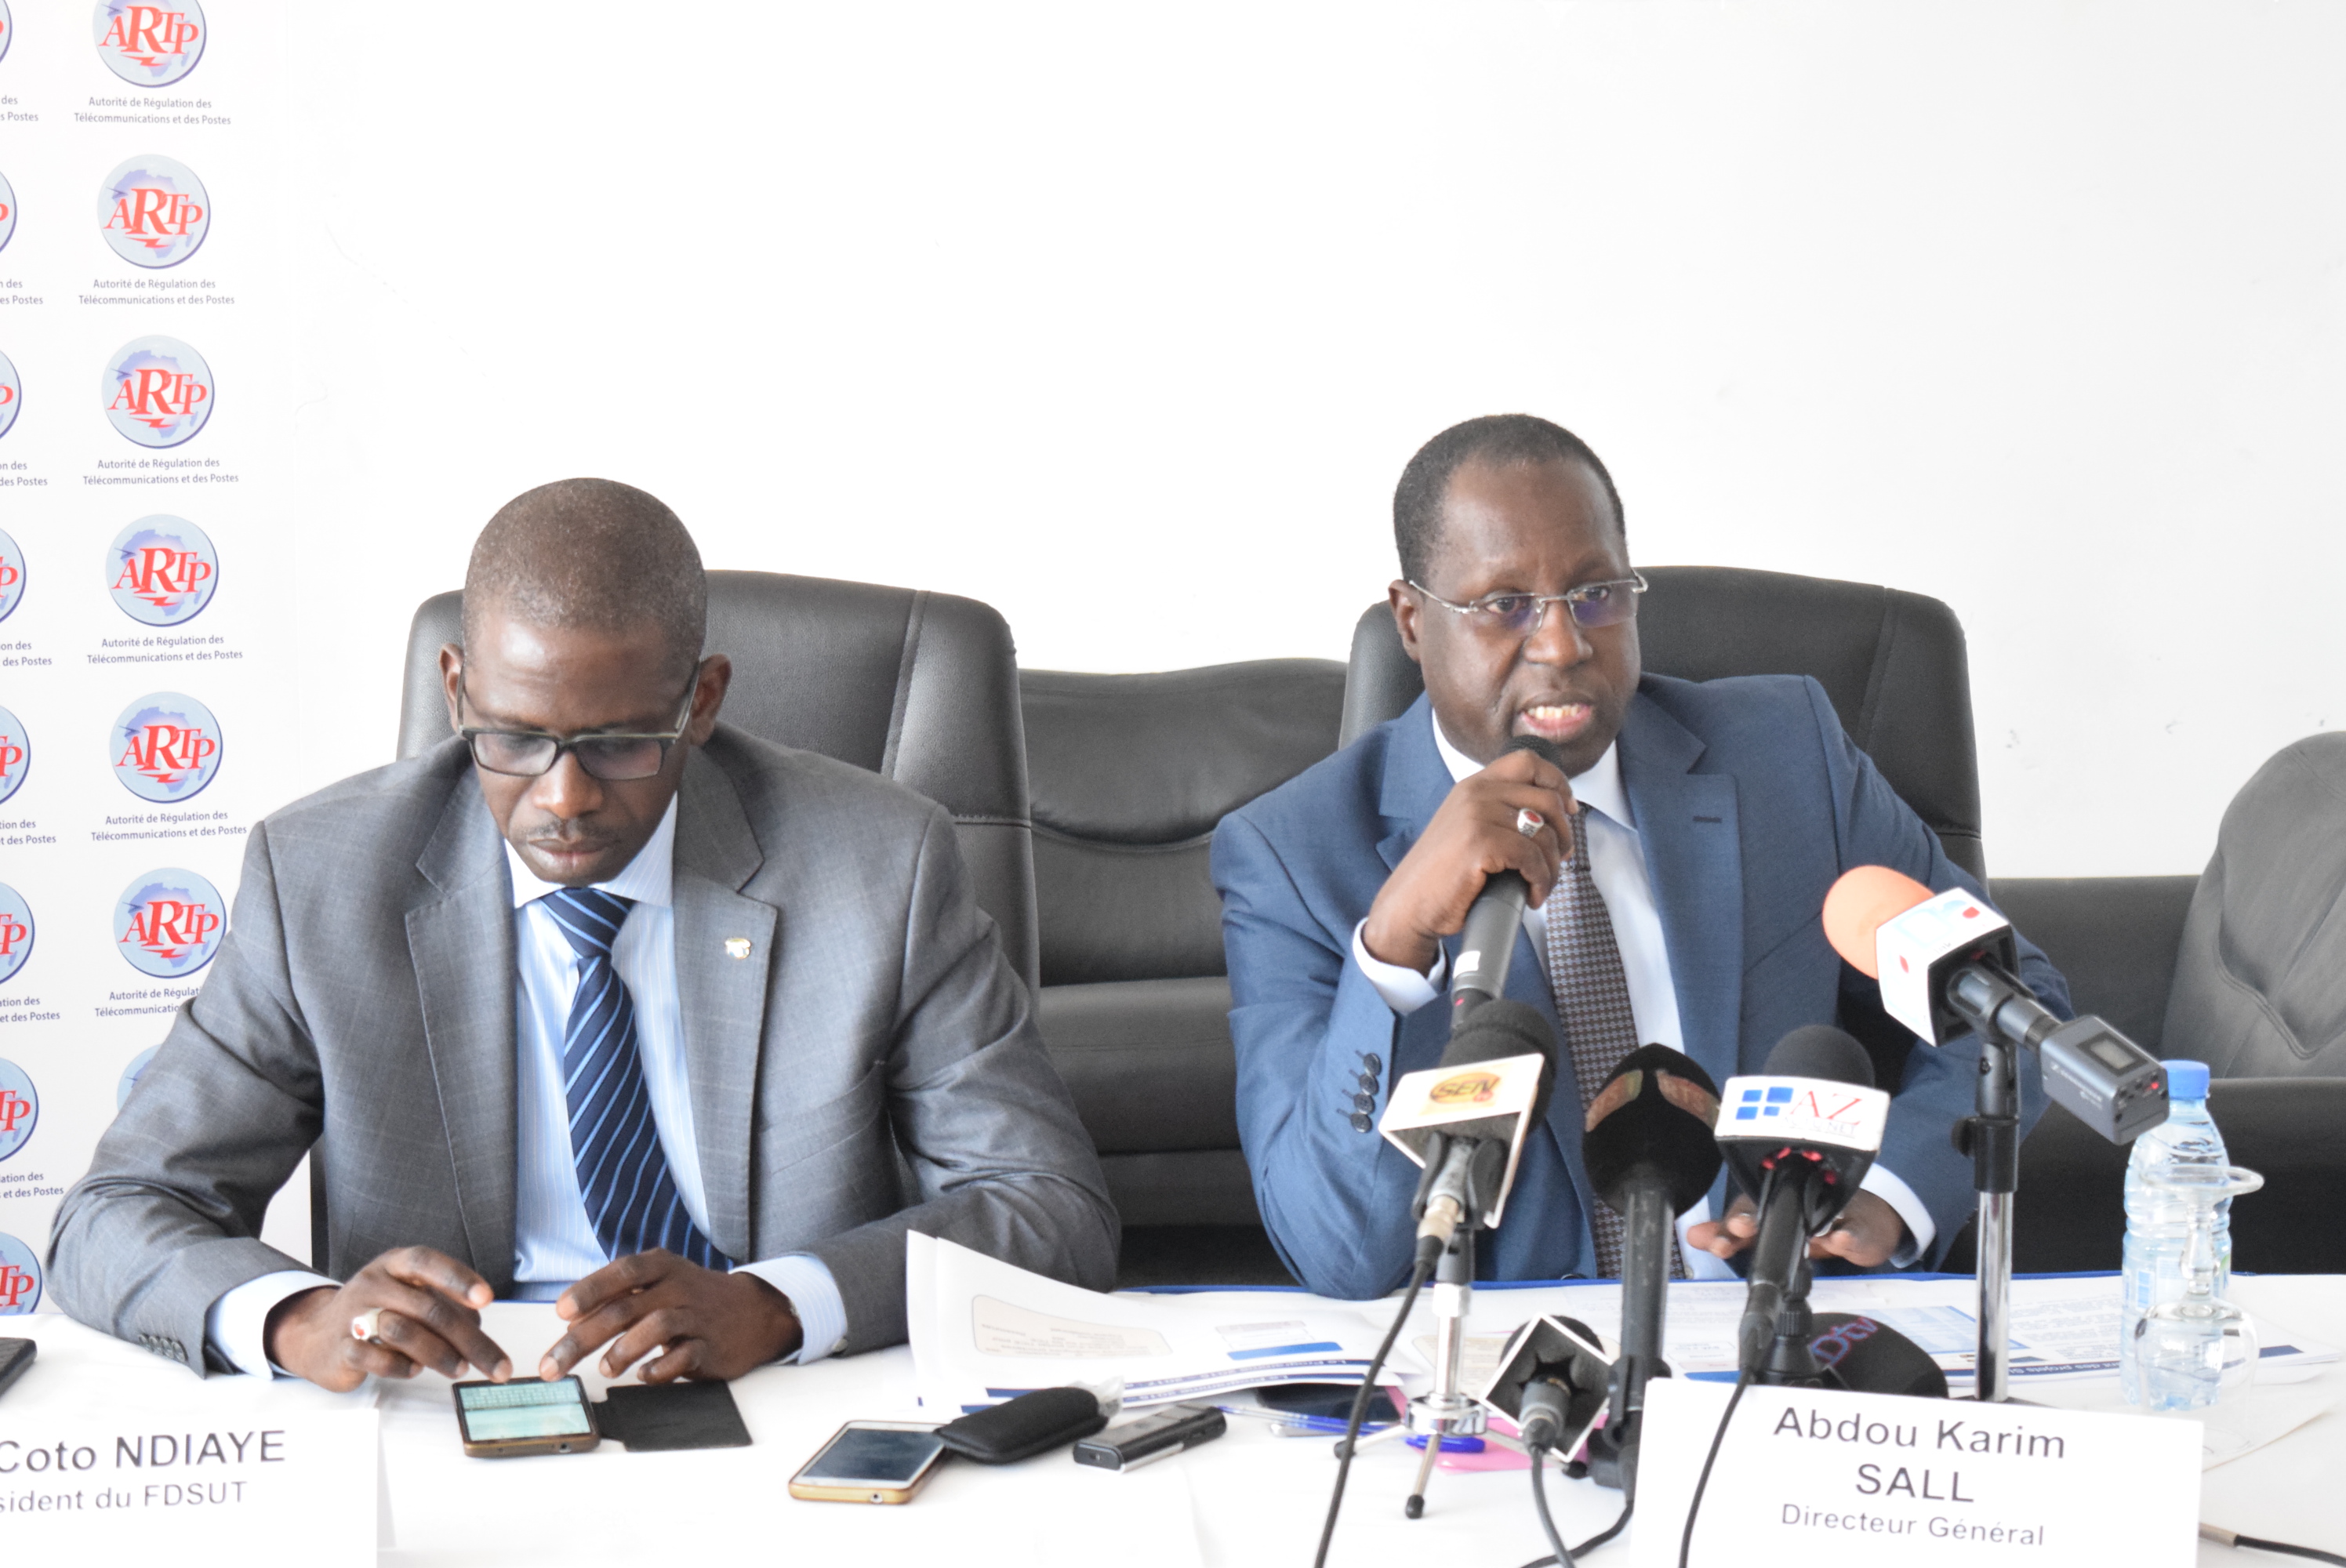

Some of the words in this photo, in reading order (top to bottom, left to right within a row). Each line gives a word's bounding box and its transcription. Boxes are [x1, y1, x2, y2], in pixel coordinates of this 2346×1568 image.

[99, 5, 198, 54] ARTP
[2, 95, 17, 105] des
[89, 97, 127, 107] Autorité
[130, 97, 141, 107] de
[144, 98, 193, 109] Régulation
[196, 99, 212, 108] des
[8, 112, 38, 122] Postes
[74, 113, 170, 124] Télécommunications
[172, 115, 181, 124] et
[184, 115, 199, 125] des
[202, 115, 231, 125] Postes
[103, 188, 202, 235] ARTP
[6, 279, 22, 289] des
[93, 279, 132, 289] Autorité
[135, 279, 145, 289] de
[148, 279, 198, 290] Régulation
[201, 279, 216, 289] des
[13, 296, 43, 305] Postes
[79, 295, 174, 304] Télécommunications
[177, 296, 185, 304] et
[188, 295, 203, 304] des
[206, 296, 234, 304] Postes
[107, 368, 207, 415] ARTP
[11, 461, 27, 470] des
[98, 459, 136, 469] Autorité
[139, 459, 150, 469] de
[153, 459, 202, 470] Régulation
[205, 458, 220, 467] des
[17, 477, 47, 486] Postes
[83, 475, 179, 485] Télécommunications
[181, 475, 190, 484] et
[193, 474, 208, 484] des
[211, 474, 239, 483] Postes
[111, 547, 211, 593] ARTP
[16, 641, 31, 651] des
[102, 637, 140, 648] Autorité
[143, 637, 154, 647] de
[157, 636, 206, 648] Régulation
[209, 635, 223, 644] des
[2, 657, 19, 666] des
[22, 657, 52, 666] Postes
[87, 652, 183, 663] Télécommunications
[186, 652, 194, 661] et
[197, 651, 212, 660] des
[215, 651, 243, 659] Postes
[116, 724, 216, 771] ARTP
[20, 819, 36, 829] des
[106, 815, 143, 825] Autorité
[147, 814, 158, 823] de
[161, 812, 210, 824] Régulation
[212, 811, 227, 821] des
[91, 829, 187, 841] Télécommunications
[189, 829, 198, 837] et
[201, 827, 216, 837] des
[218, 826, 247, 836] Postes
[7, 836, 24, 845] des
[26, 835, 56, 844] Postes
[119, 900, 219, 946] ARTP
[109, 990, 147, 1000] Autorité
[150, 989, 162, 998] de
[164, 986, 201, 999] Régulat
[24, 996, 40, 1006] des
[95, 1004, 180, 1017] Télécommunicatio
[11, 1013, 27, 1022] des
[30, 1012, 60, 1022] Postes
[1790, 1091, 1862, 1127] AZ
[27, 1172, 44, 1181] des
[3, 1190, 13, 1200] et
[15, 1189, 31, 1198] des
[34, 1187, 64, 1197] Postes
[0, 1265, 34, 1307] TP
[1773, 1406, 1918, 1447] Abdou
[1937, 1419, 2065, 1459] Karim
[0, 1441, 96, 1474] Coto
[115, 1429, 285, 1468] NDIAYE
[1855, 1463, 1974, 1503] SALL
[0, 1490, 82, 1512] sident
[95, 1487, 131, 1509] du
[144, 1481, 247, 1506] FDSUT
[1781, 1503, 1917, 1534] Directeur
[1928, 1516, 2043, 1546] Général
